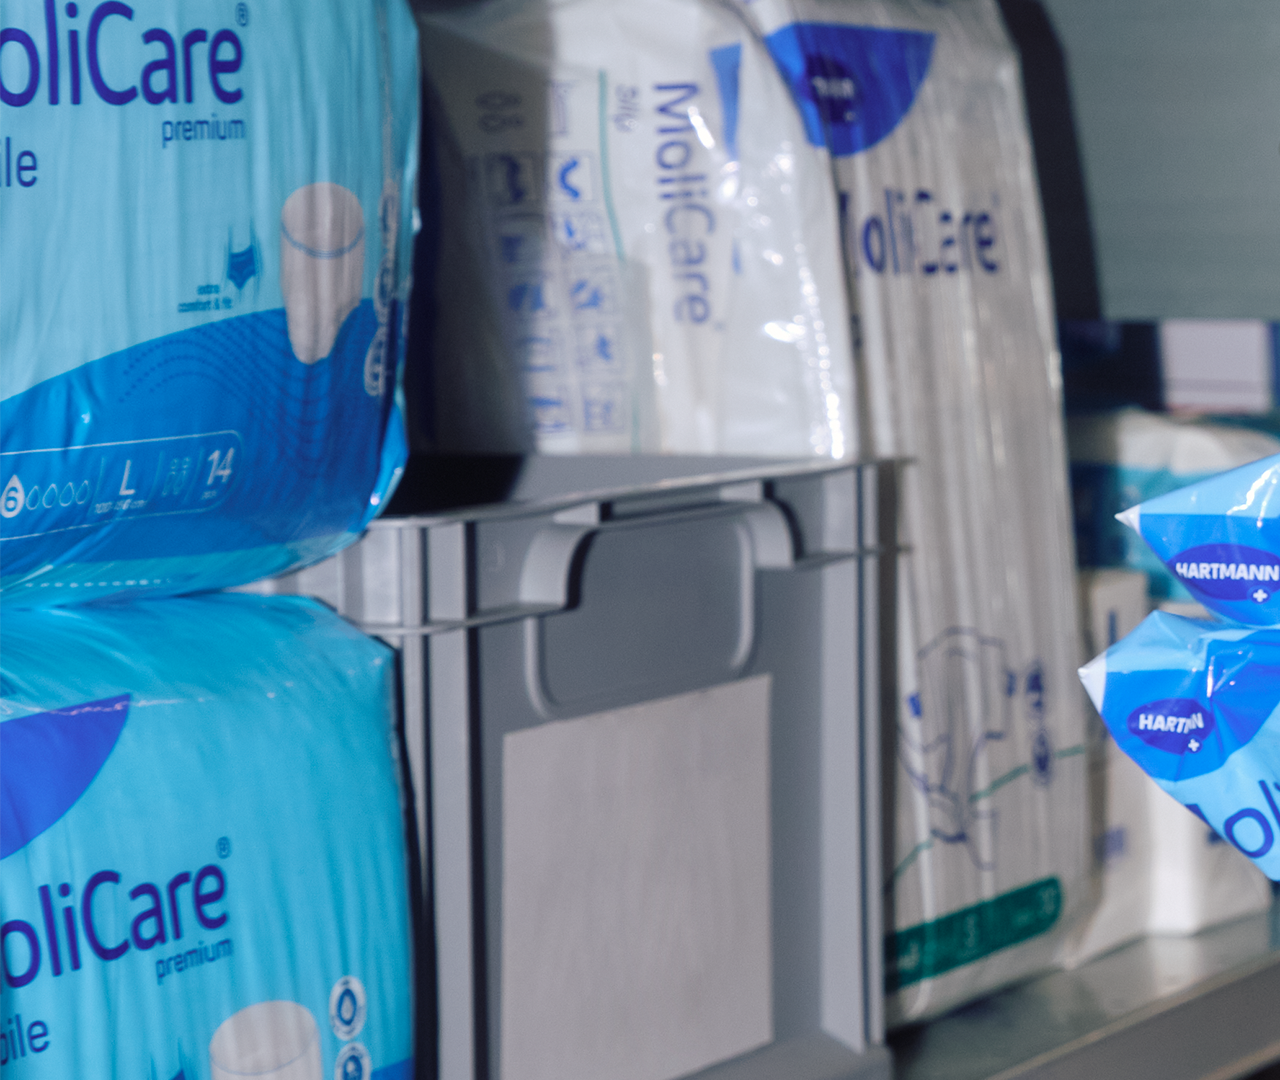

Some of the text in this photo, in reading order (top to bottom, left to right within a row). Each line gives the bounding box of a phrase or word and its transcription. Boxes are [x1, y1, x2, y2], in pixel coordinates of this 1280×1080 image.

[161, 113, 246, 149] premium
[0, 135, 38, 189] le
[119, 459, 136, 497] L
[206, 446, 235, 487] 14
[1175, 562, 1280, 581] HARTMANN
[155, 938, 234, 985] premium
